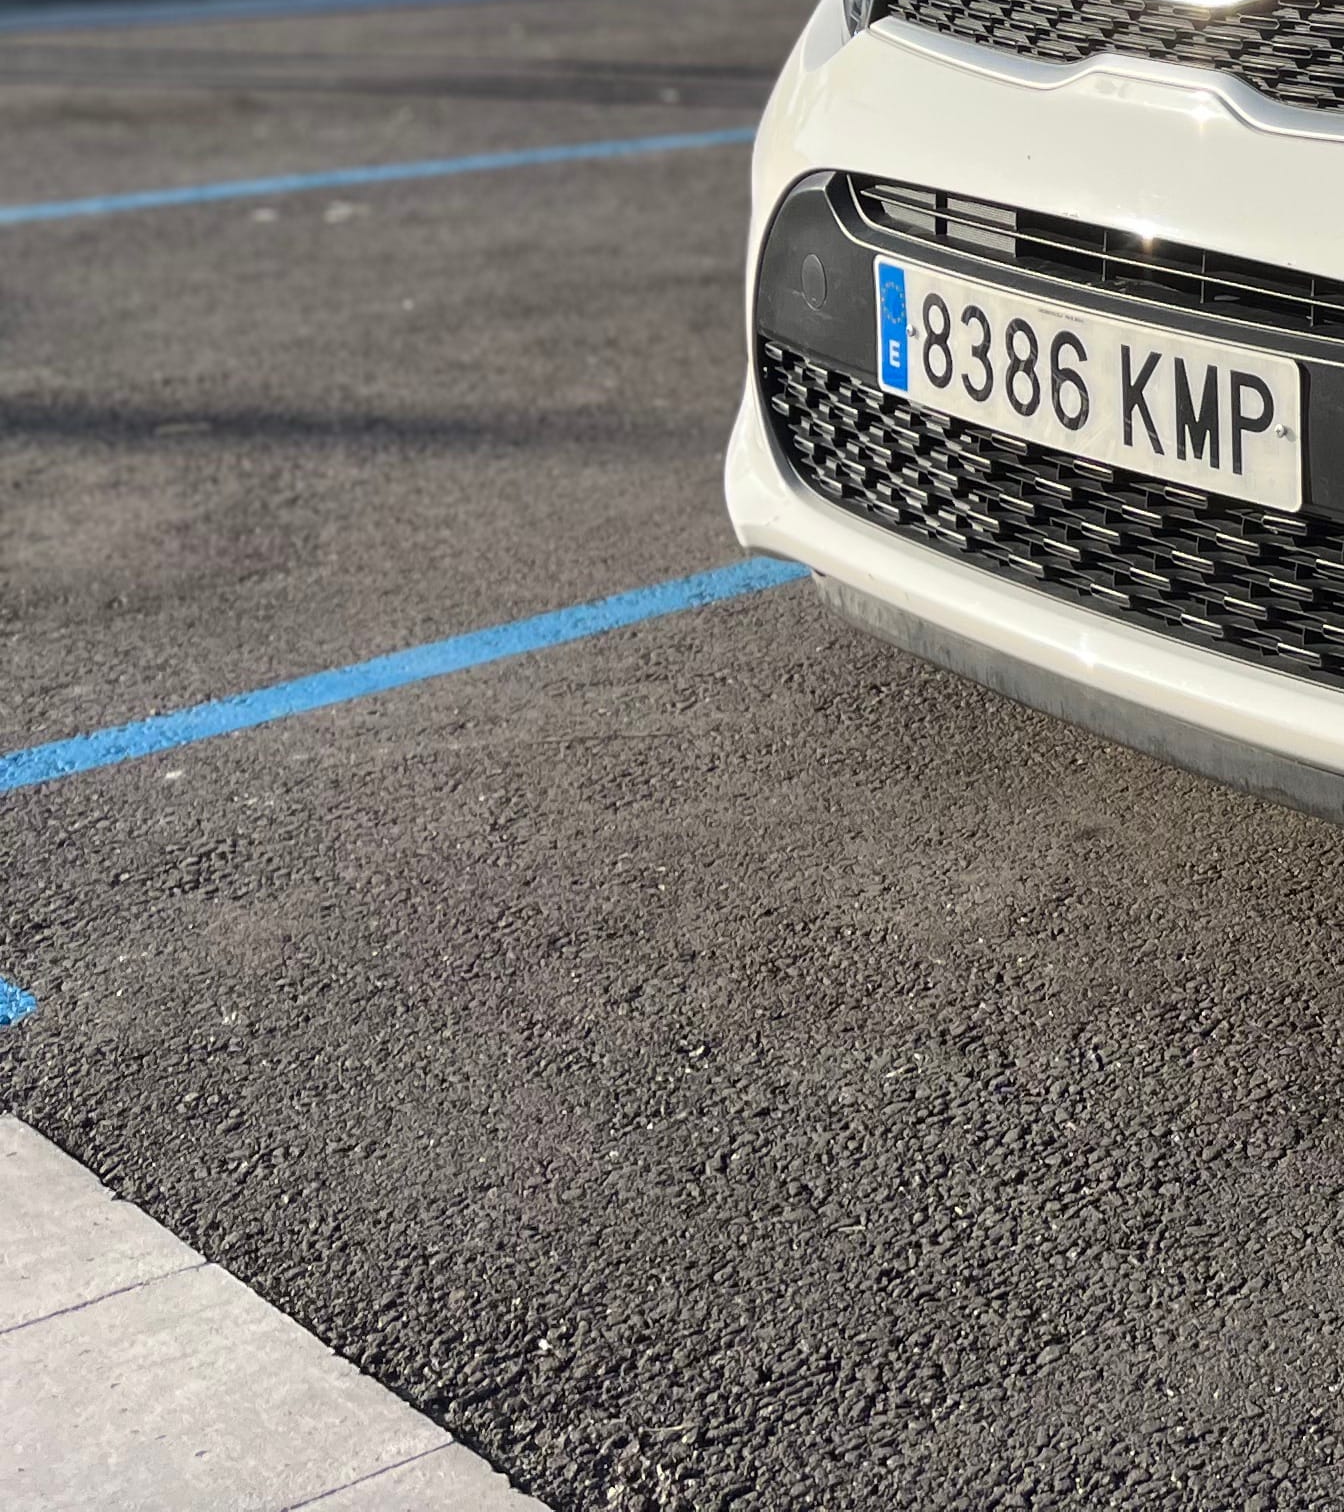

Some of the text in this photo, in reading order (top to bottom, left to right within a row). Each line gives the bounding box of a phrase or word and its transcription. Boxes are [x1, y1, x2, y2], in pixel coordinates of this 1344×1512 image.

[888, 339, 900, 368] E
[922, 292, 1275, 476] 8386 KMP
